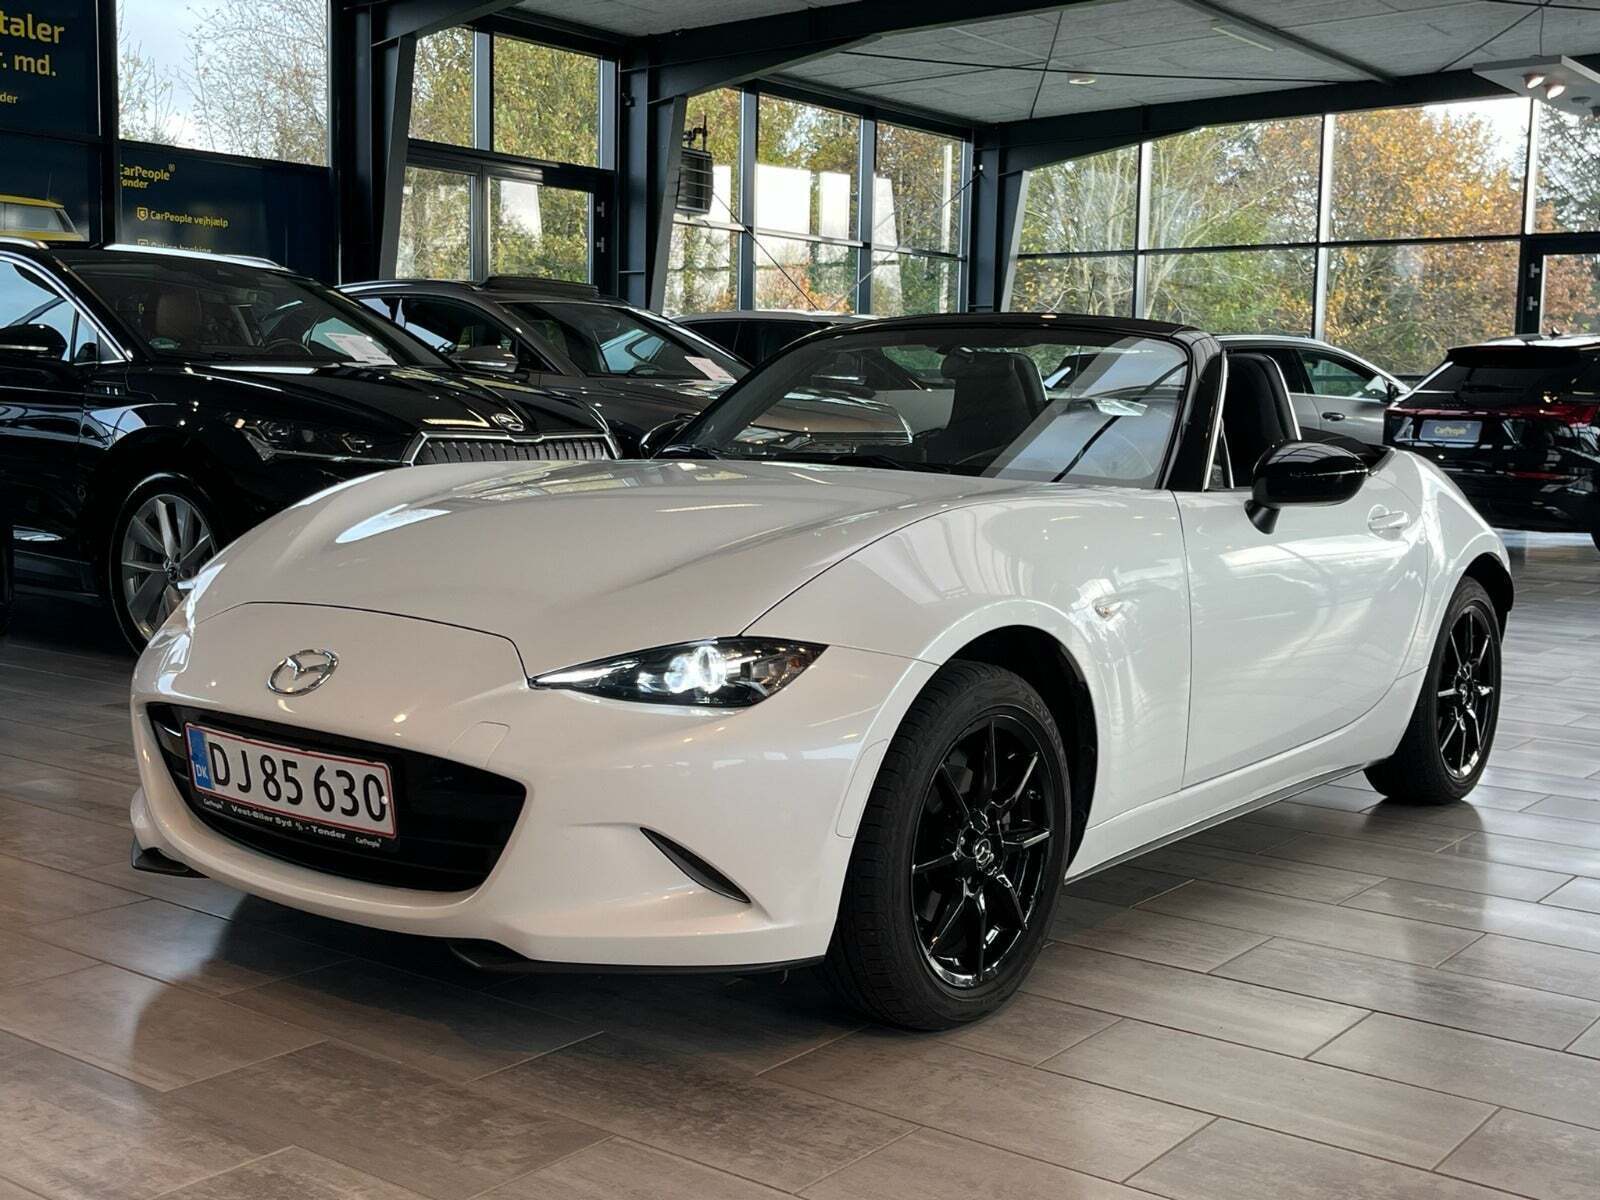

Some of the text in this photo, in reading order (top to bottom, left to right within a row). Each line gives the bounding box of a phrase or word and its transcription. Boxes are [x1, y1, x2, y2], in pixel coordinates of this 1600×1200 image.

[14, 54, 57, 77] md.
[150, 210, 192, 224] CarPeople
[195, 763, 208, 779] DK
[208, 741, 387, 822] DJ 85 630
